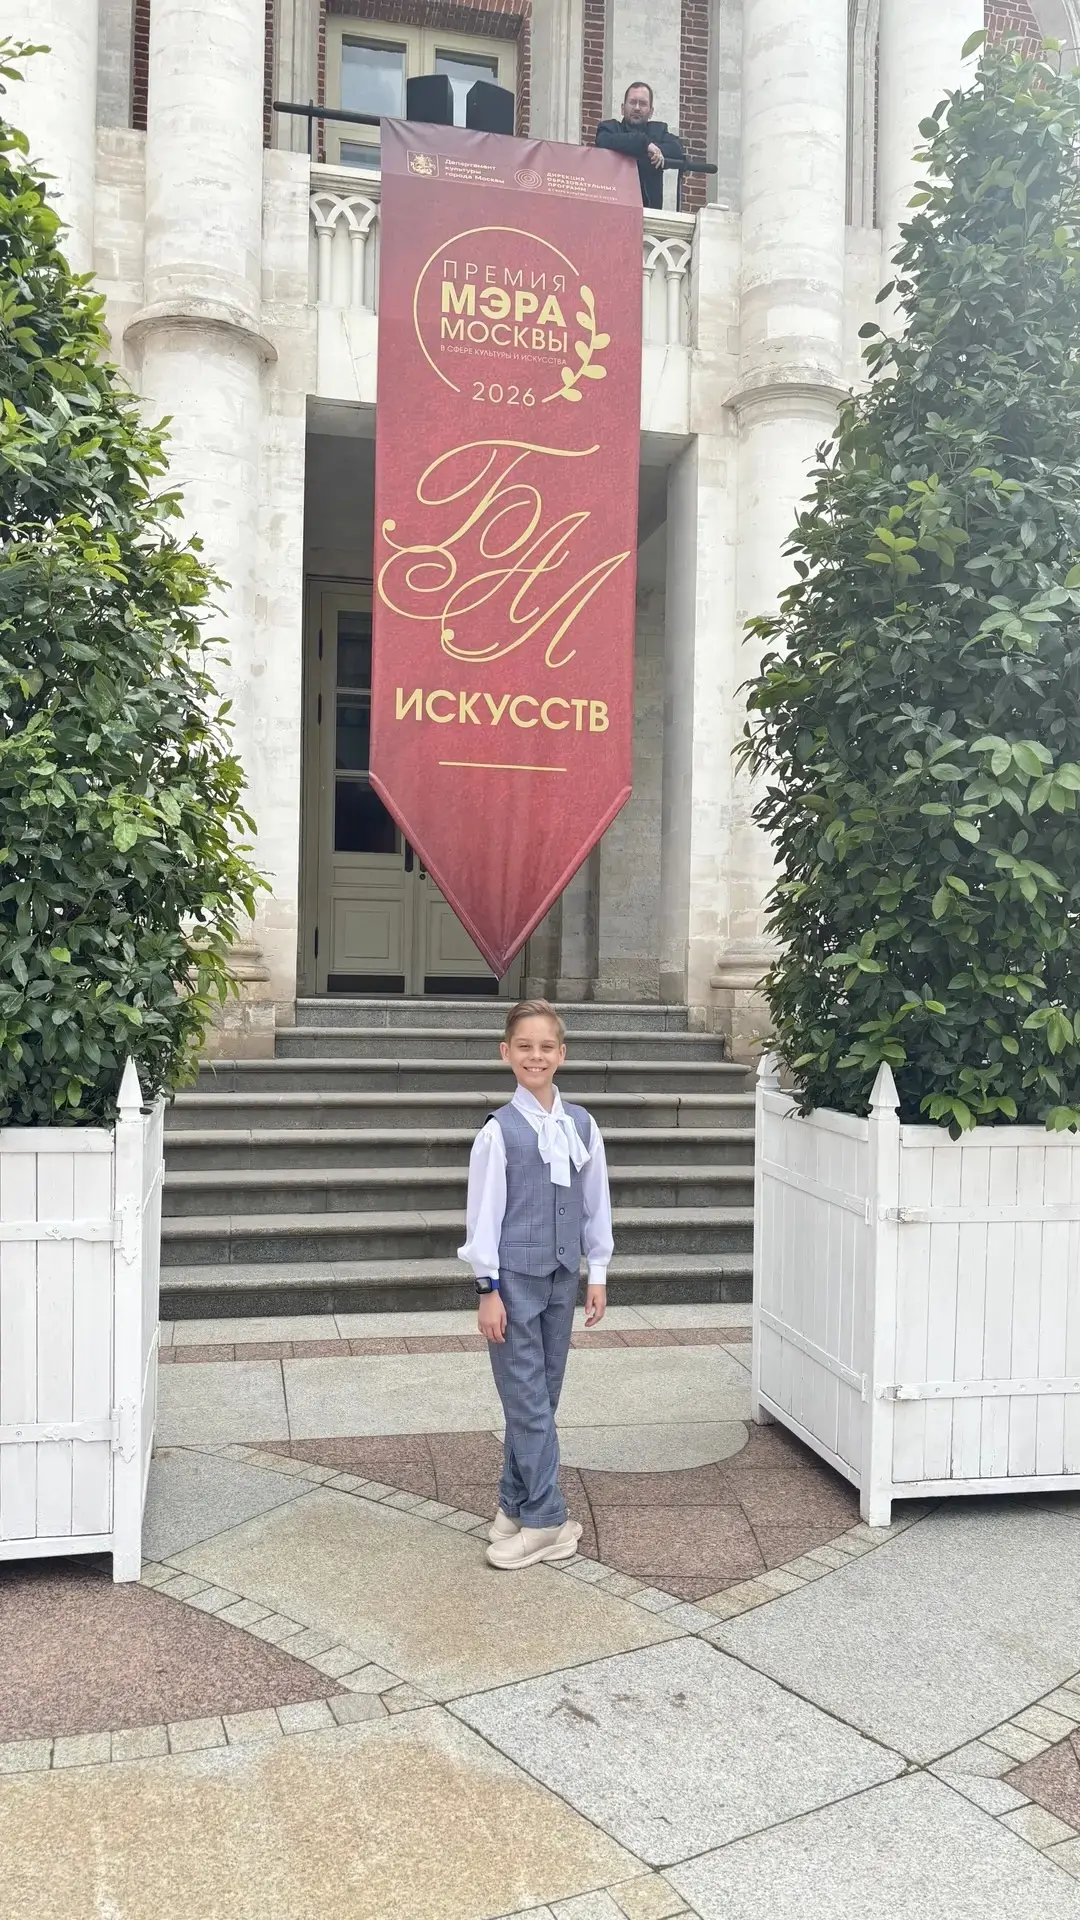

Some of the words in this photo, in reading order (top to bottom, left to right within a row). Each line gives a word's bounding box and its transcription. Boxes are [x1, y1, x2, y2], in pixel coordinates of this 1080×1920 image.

[445, 159, 496, 170] Департамент
[445, 166, 482, 174] культуры
[475, 175, 504, 183] Москвы
[547, 172, 585, 181] ДИРЕКЦИЯ
[547, 178, 616, 190] ОБРАЗОВАТЕЛЬНЫХ
[548, 182, 586, 191] ПРОГРАММ
[443, 260, 566, 292] ПРЕМИЯ
[441, 281, 567, 327] МЭРА
[441, 317, 568, 352] МОСКВЫ
[447, 346, 472, 355] СФЕРЕ
[475, 348, 512, 359] КУЛЬТУРЫ
[521, 354, 567, 365] ИСКУССТВА
[472, 381, 536, 406] 2026
[395, 687, 610, 732] ИСКУССТВ
